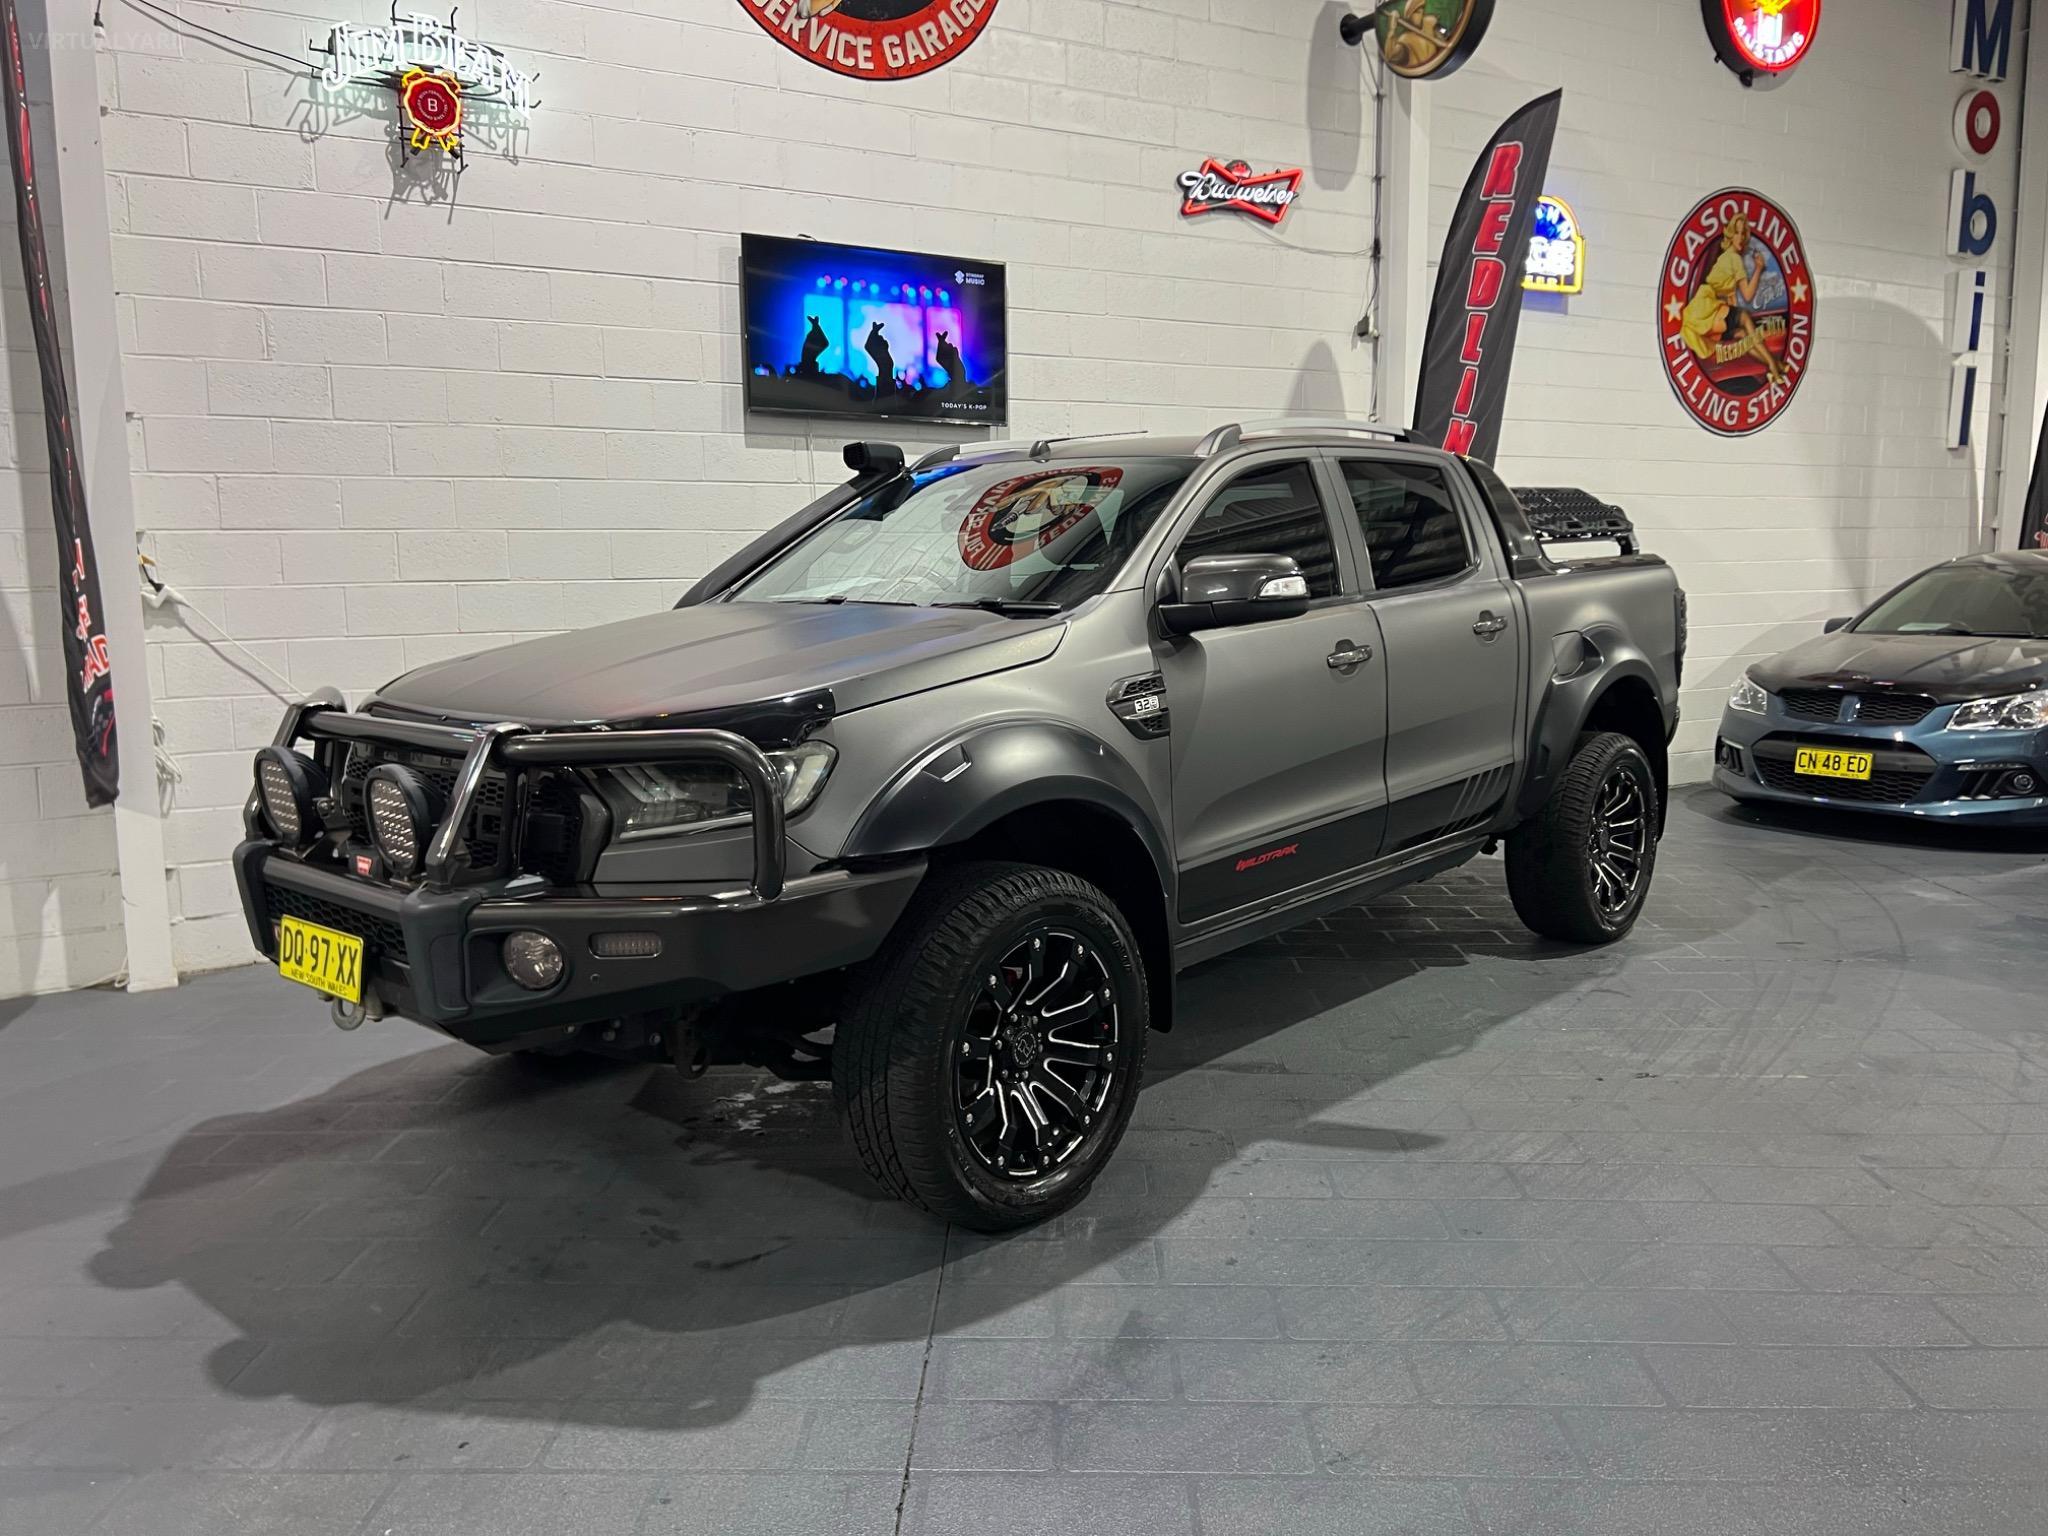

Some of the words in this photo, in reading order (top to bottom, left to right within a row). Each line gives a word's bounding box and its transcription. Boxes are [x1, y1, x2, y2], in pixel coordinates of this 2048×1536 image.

[1734, 17, 1804, 63] MUSTANG
[428, 98, 438, 111] B
[1181, 171, 1294, 204] Budweiser
[1958, 0, 2012, 447] Mobil
[1670, 199, 1799, 288] GASOLINE
[1667, 333, 1740, 426] FILLING
[941, 402, 967, 410] TODAY'S
[306, 974, 325, 988] SOUTH
